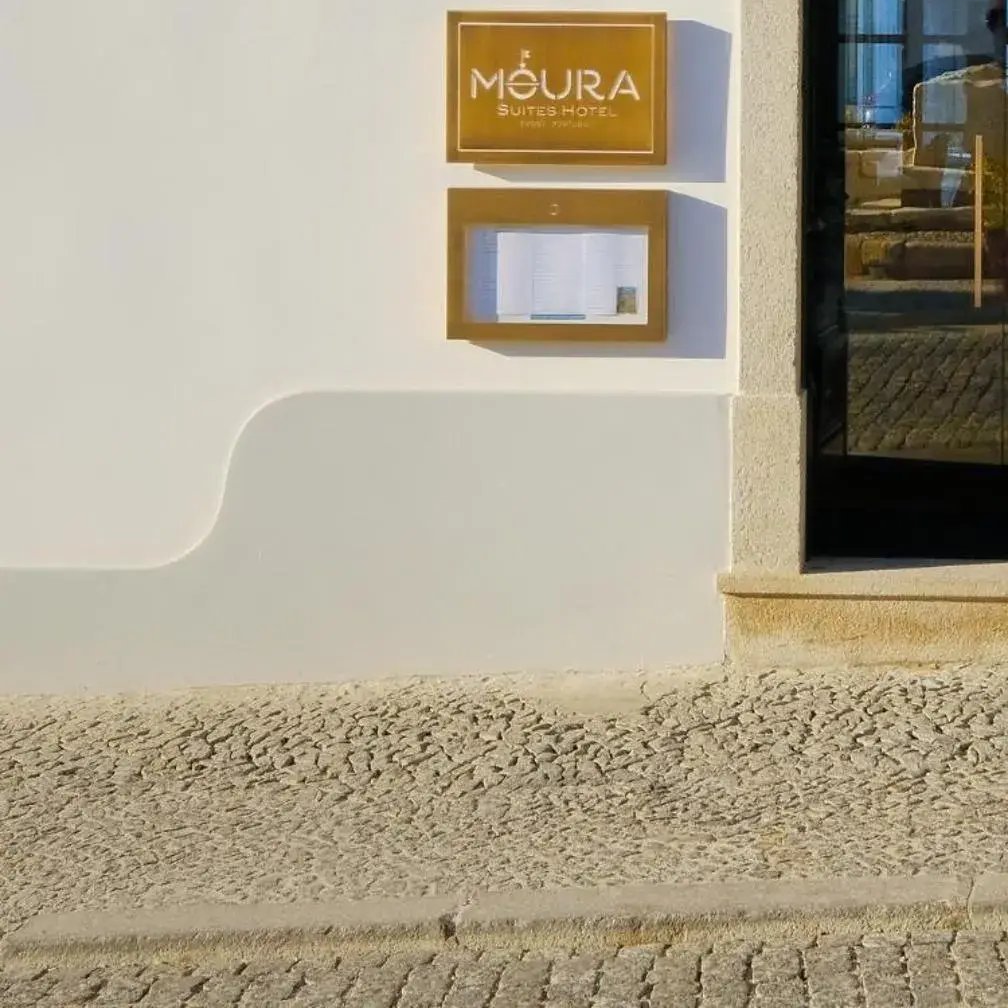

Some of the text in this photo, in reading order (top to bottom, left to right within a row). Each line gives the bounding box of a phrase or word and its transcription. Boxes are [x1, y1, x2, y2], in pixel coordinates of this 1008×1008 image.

[469, 67, 641, 101] MOURA
[497, 104, 618, 118] SUITES HOTEL
